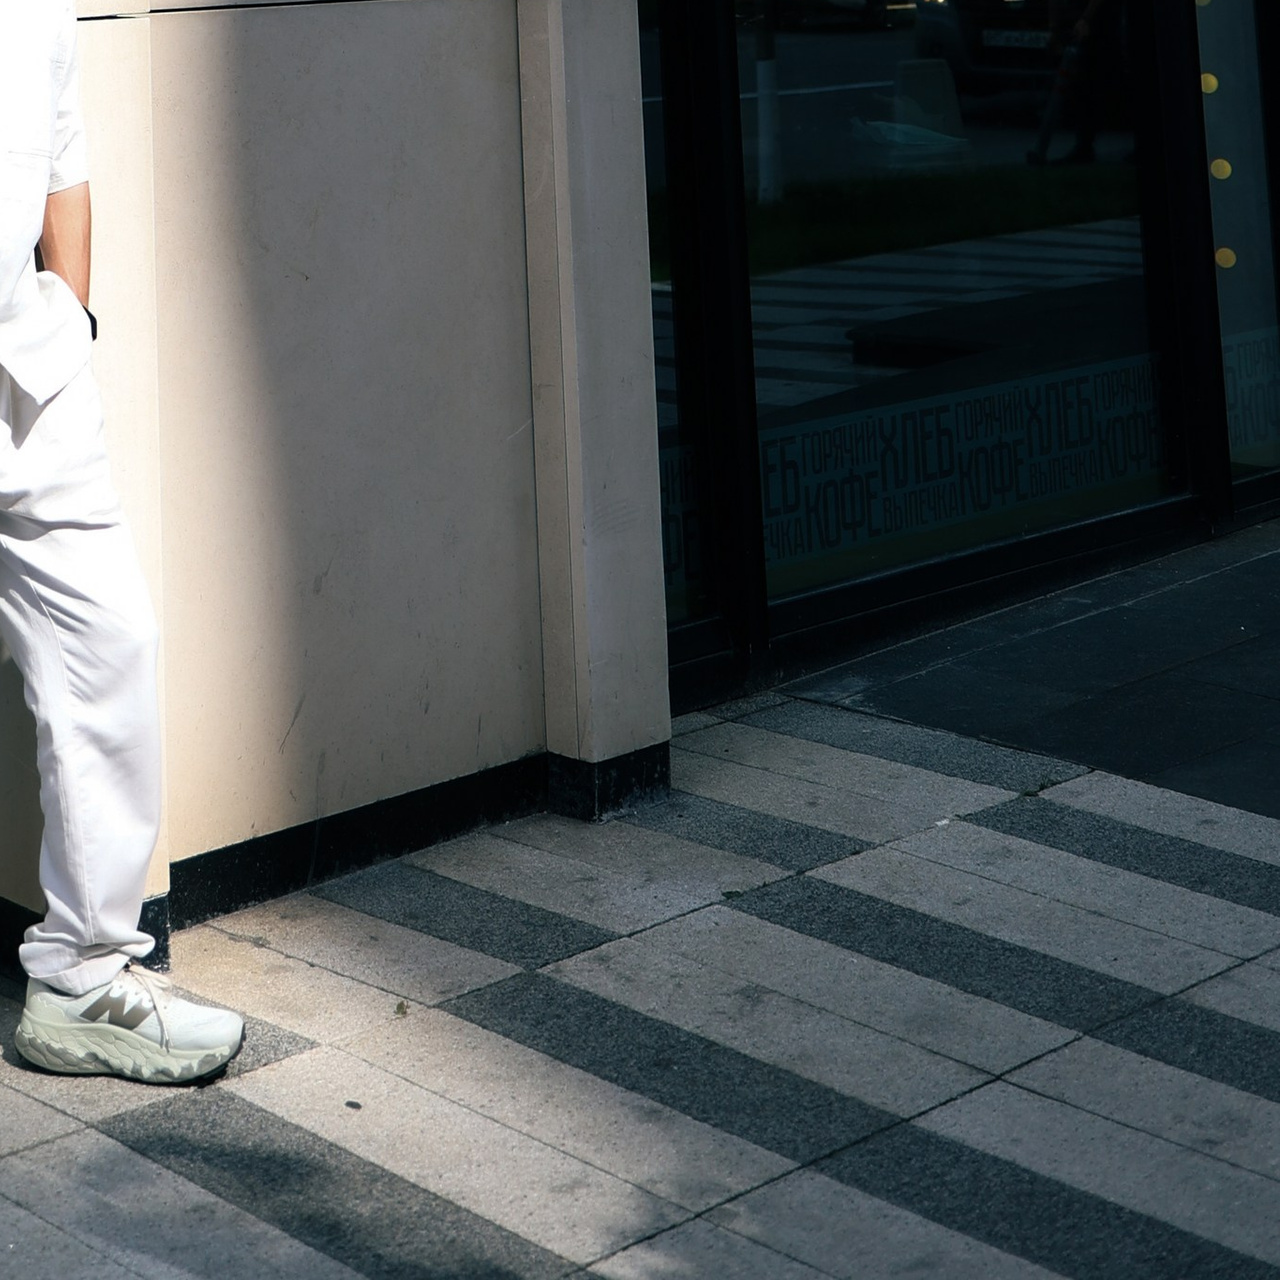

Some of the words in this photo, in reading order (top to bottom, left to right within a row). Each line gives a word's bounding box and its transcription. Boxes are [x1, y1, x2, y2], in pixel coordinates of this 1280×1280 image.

[802, 415, 879, 478] ГОРЯЧИЙ
[878, 405, 955, 492] ХЛЕБ
[956, 385, 1025, 444] ГОРЯЧИЙ
[1024, 375, 1093, 458] ХЛЕБ
[804, 468, 882, 554] КОФЕ
[883, 481, 961, 534] ВЫПЕЧКА
[958, 436, 1029, 517] КОФЕ
[1029, 449, 1099, 499] ВЫПЕЧКА
[1096, 405, 1161, 480] КОФЕ
